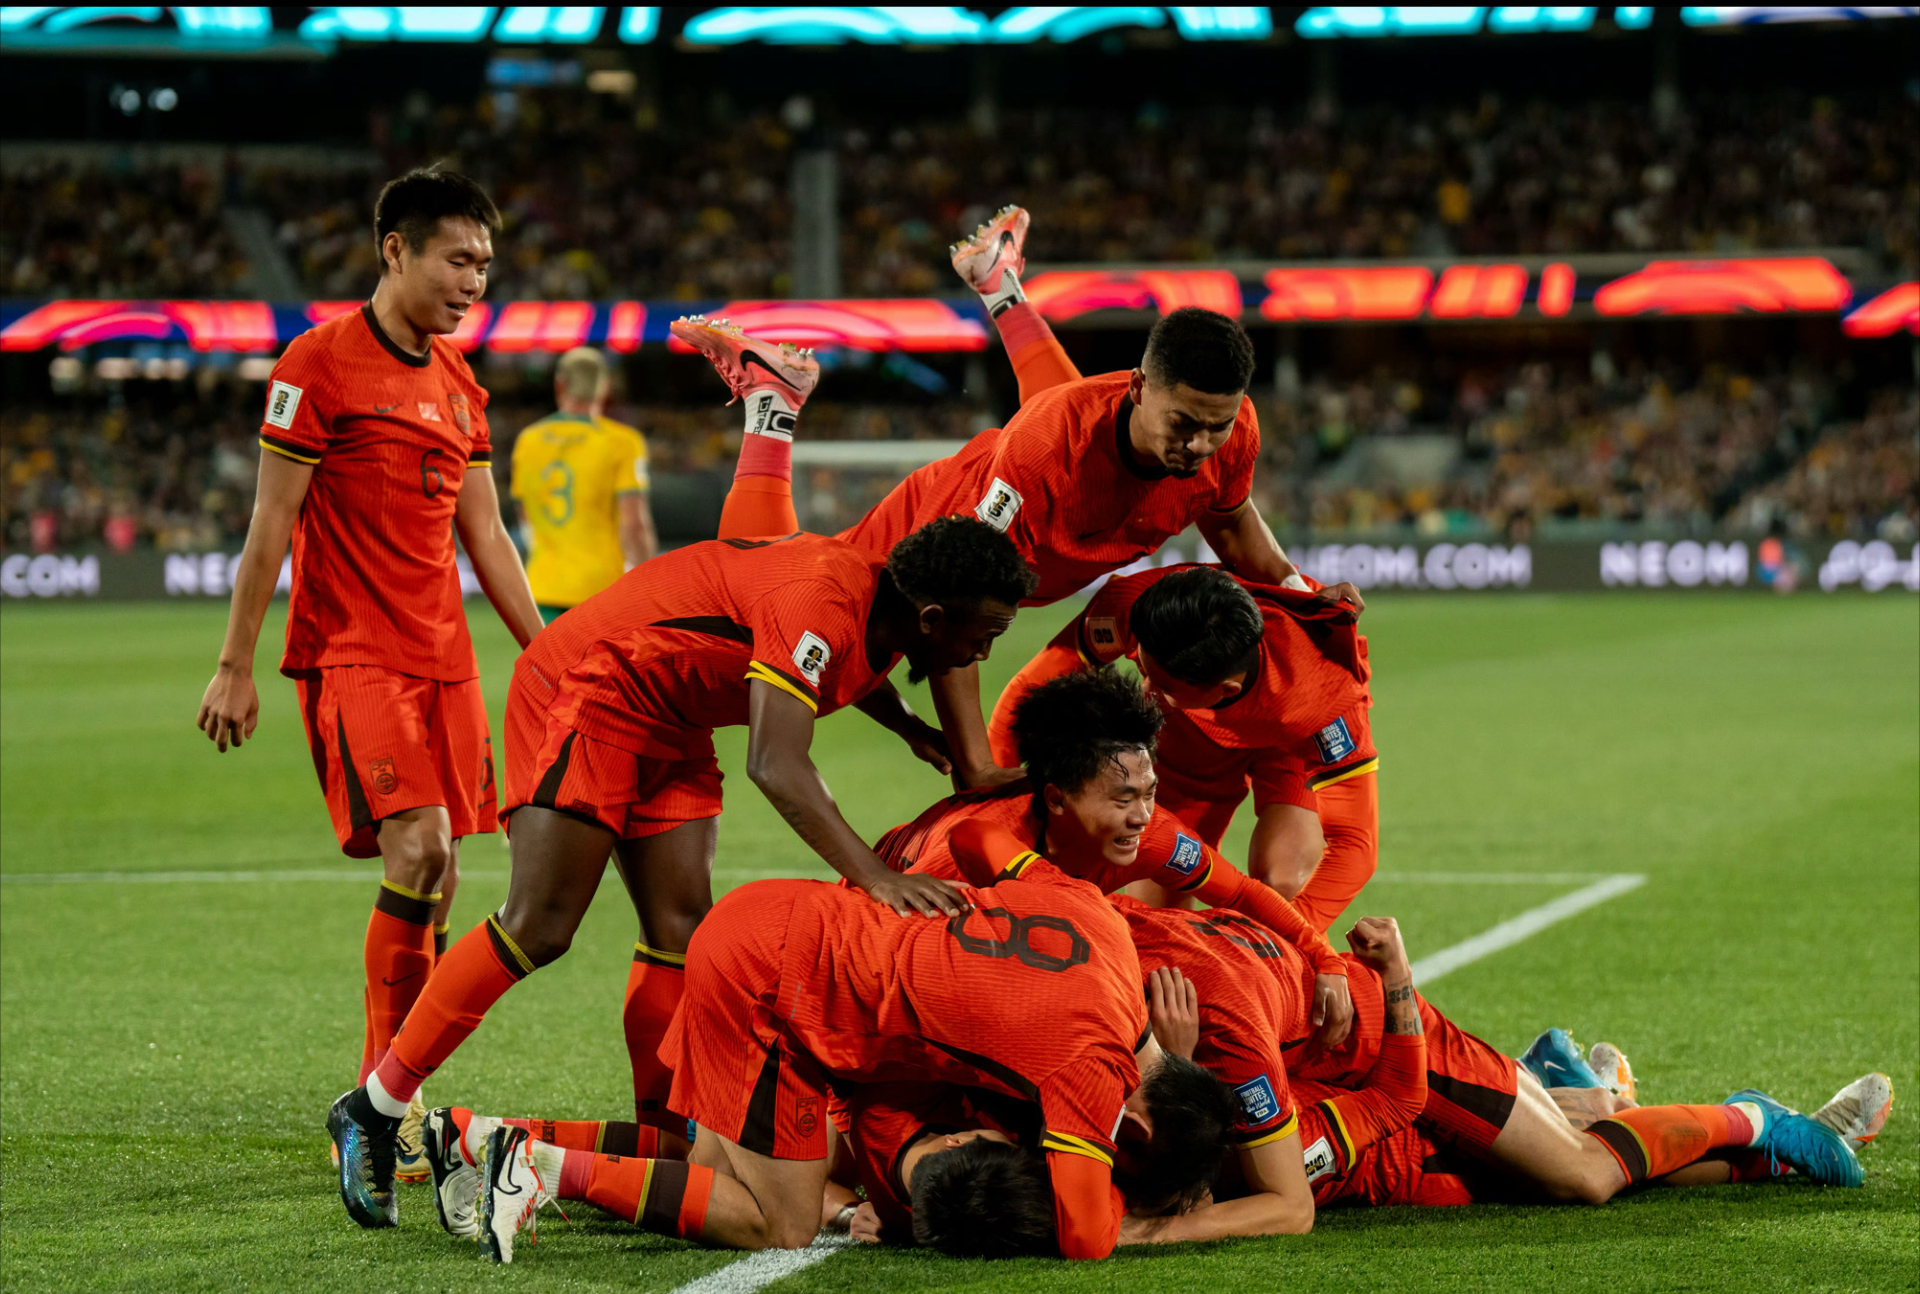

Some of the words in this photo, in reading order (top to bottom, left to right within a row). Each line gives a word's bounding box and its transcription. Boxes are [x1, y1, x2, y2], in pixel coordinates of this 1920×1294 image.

[421, 448, 444, 498] 6
[541, 459, 575, 527] 3
[1601, 541, 1748, 587] NEOM
[946, 907, 1090, 972] 8
[1240, 1084, 1264, 1098] FOOTBALL
[1243, 1090, 1267, 1106] UNITES
